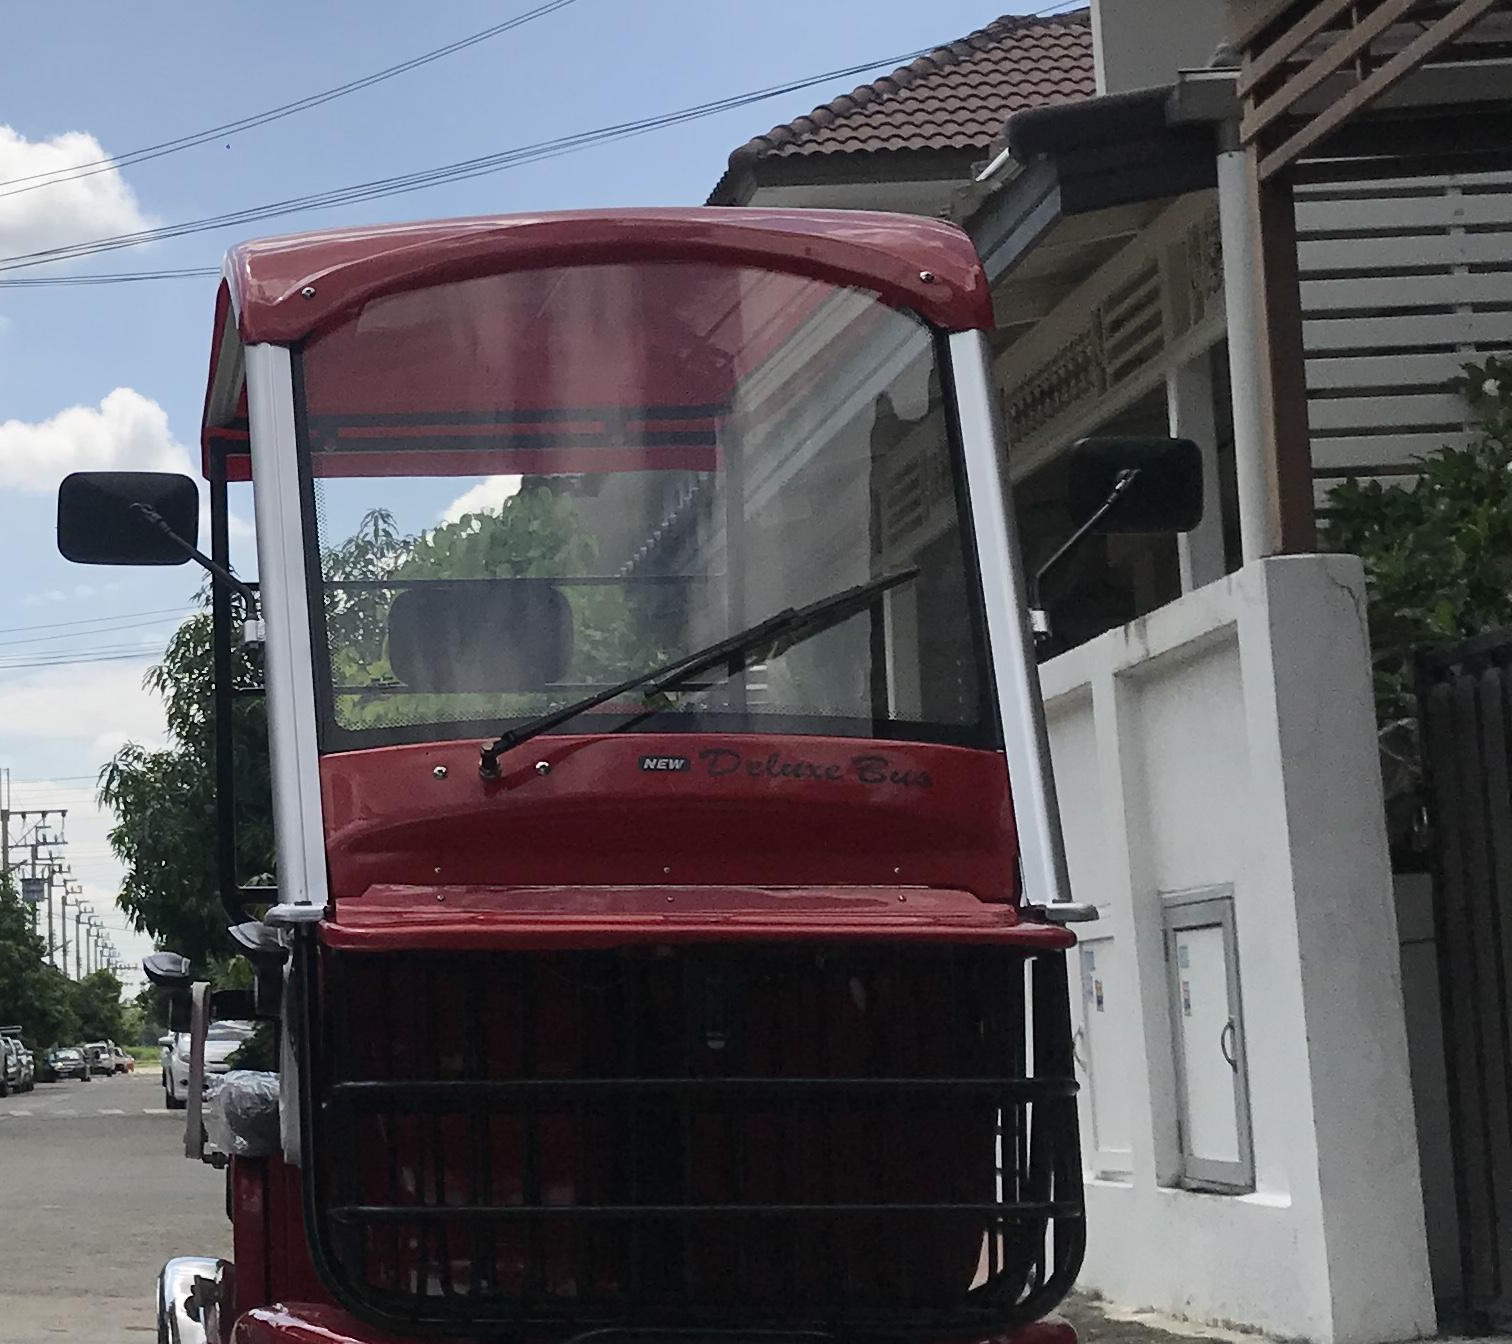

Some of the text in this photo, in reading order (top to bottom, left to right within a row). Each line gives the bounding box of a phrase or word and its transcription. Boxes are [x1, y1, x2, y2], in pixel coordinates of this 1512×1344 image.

[641, 748, 934, 789] NEW Deluxe Bus
